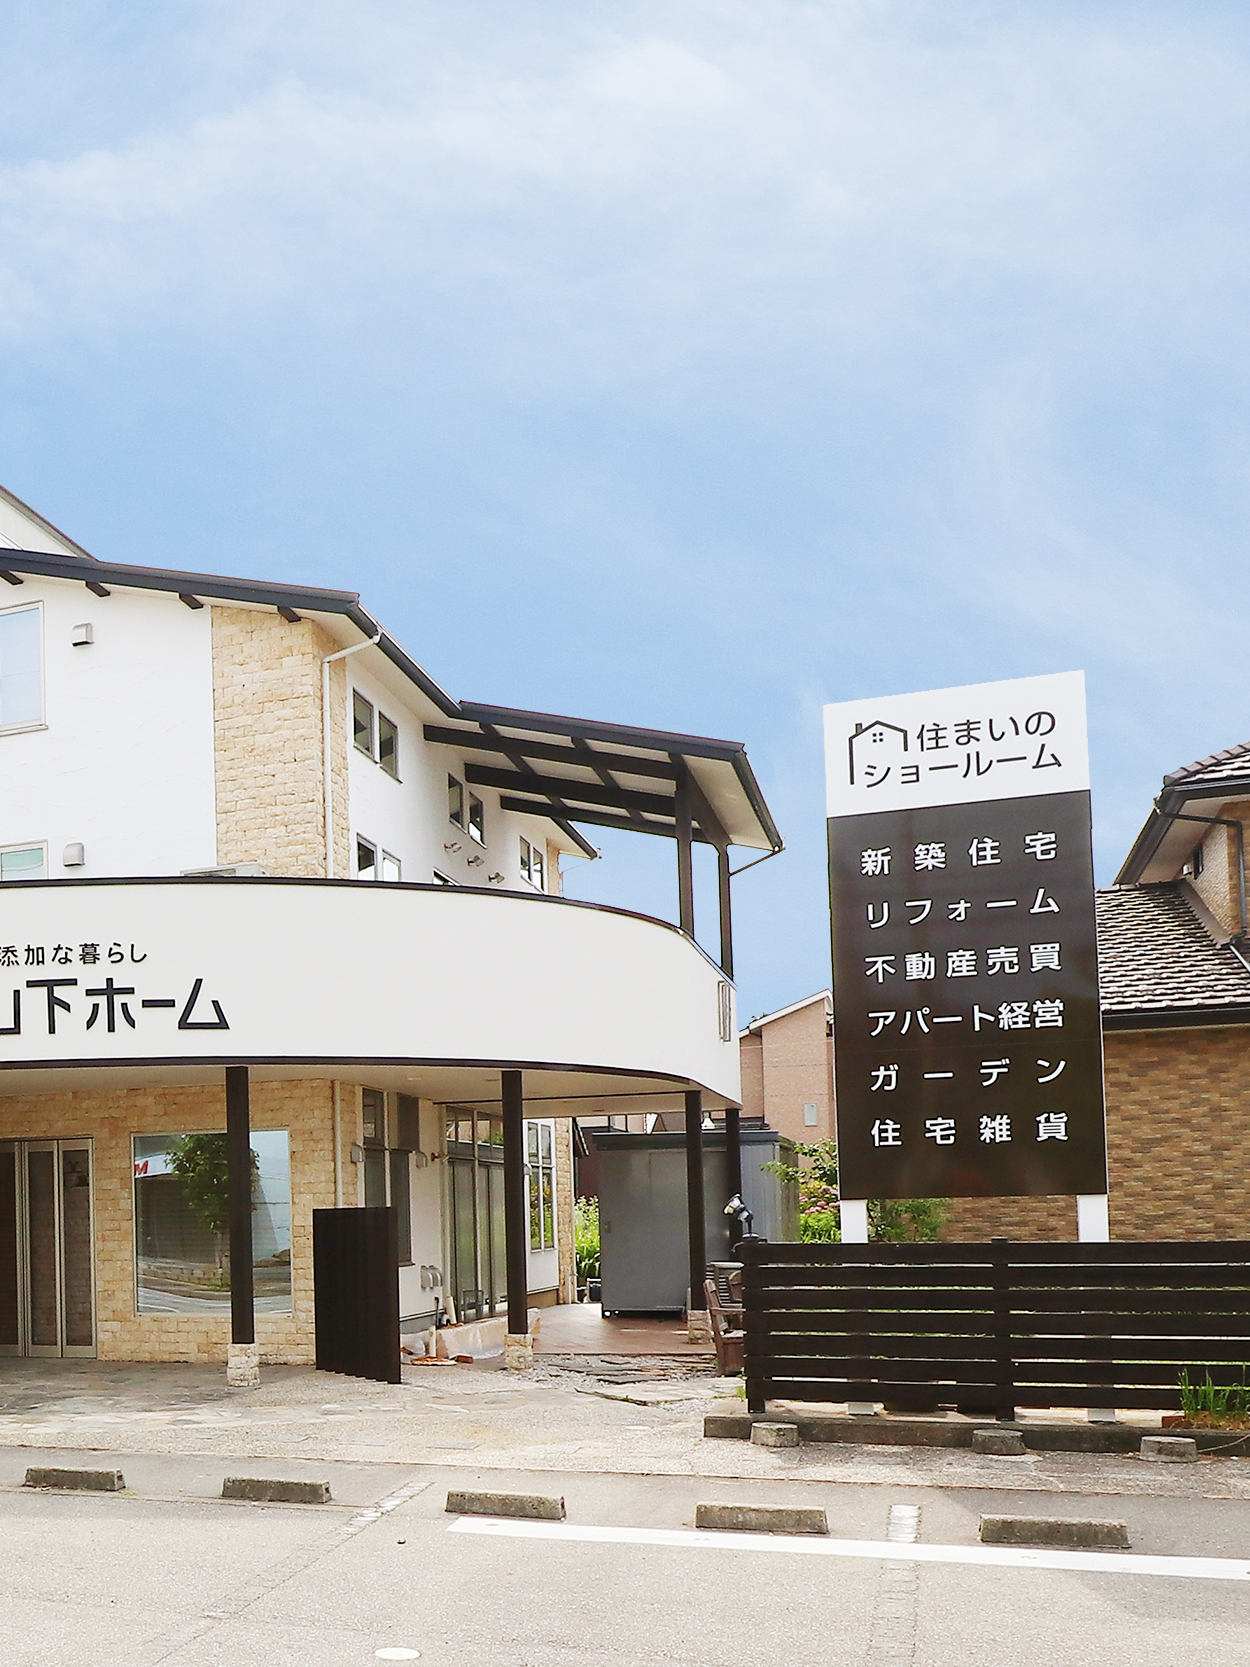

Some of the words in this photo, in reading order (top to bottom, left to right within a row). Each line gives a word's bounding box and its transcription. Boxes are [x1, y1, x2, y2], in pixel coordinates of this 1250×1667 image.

[916, 711, 1056, 752] 住まいの
[864, 743, 1062, 789] ショールーム
[860, 831, 1057, 876] 新築住宅
[867, 888, 1060, 929] リフォーム
[864, 942, 1062, 983] 不動産売買
[868, 999, 1064, 1037] アパート経営
[870, 1058, 1066, 1092] ガーデン
[870, 1112, 1069, 1148] 住宅雑貨
